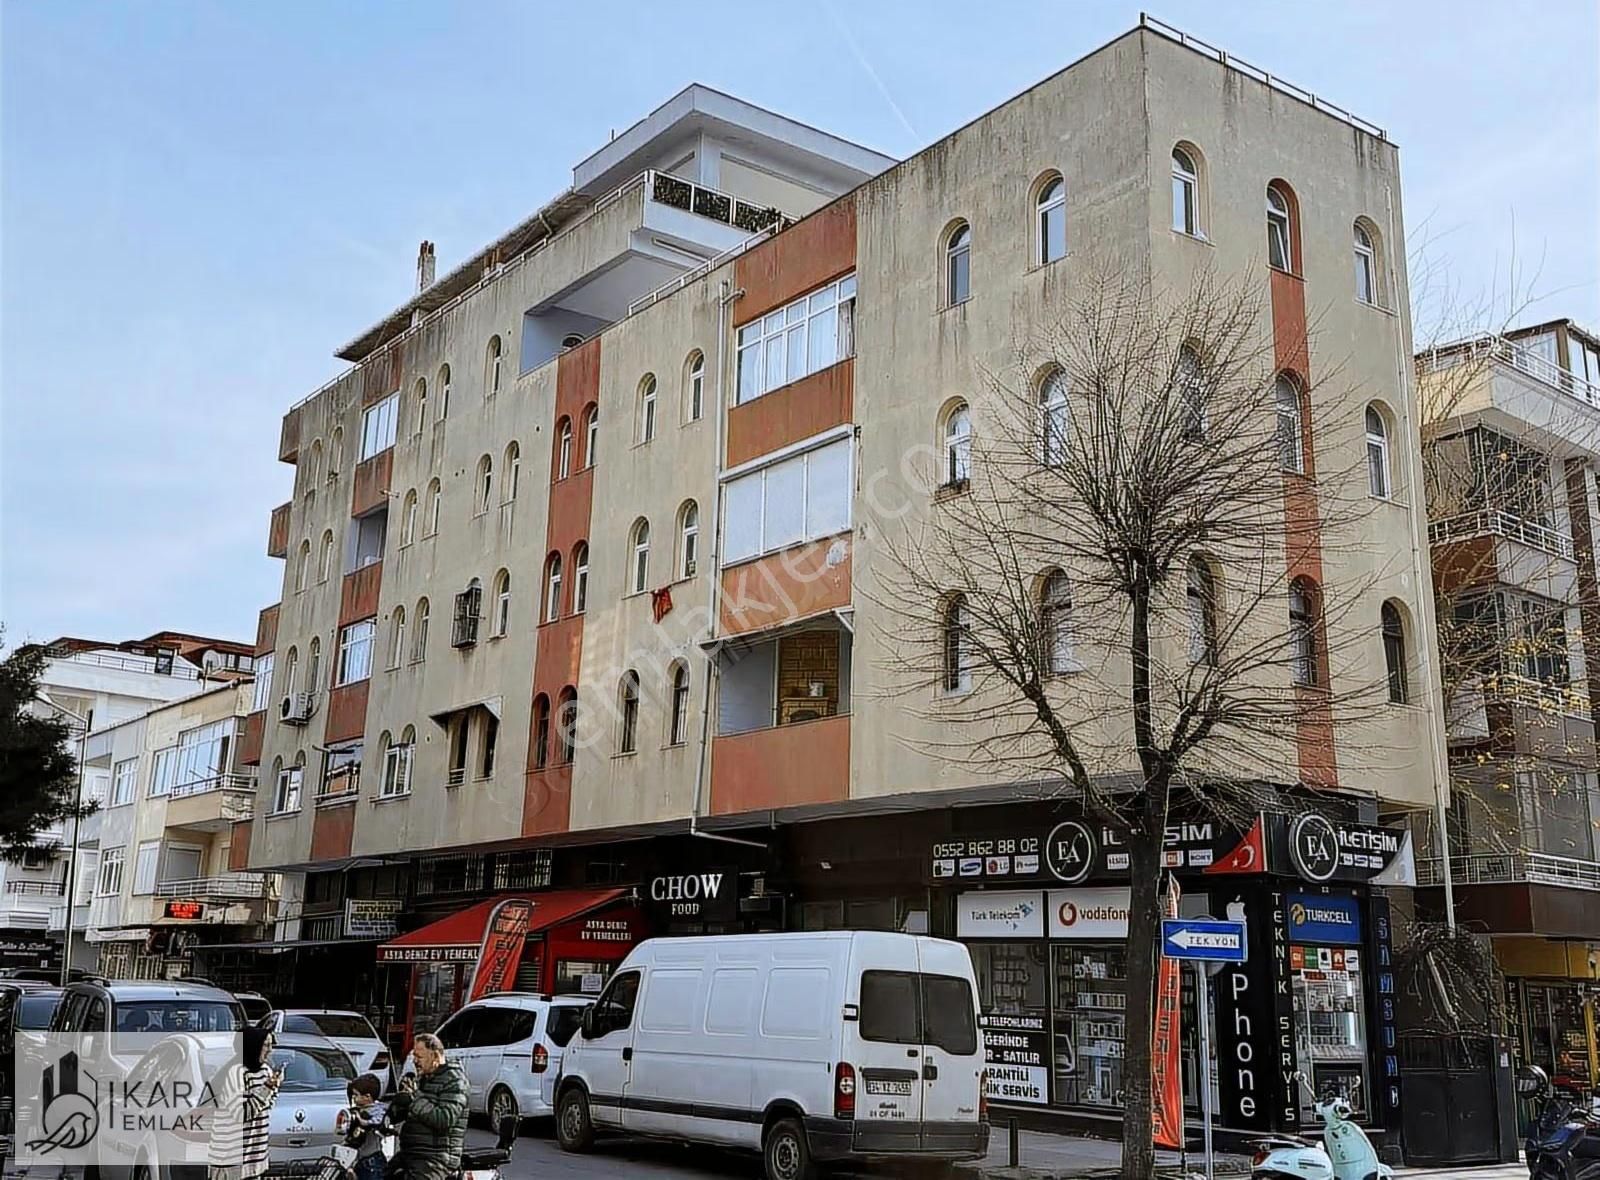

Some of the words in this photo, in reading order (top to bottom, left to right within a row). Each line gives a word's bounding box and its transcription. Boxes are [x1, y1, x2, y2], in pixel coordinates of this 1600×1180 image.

[1339, 826, 1398, 854] İLETİŞİM
[933, 843, 965, 858] 0552
[968, 840, 994, 856] 862
[998, 839, 1016, 854] 88
[1020, 838, 1039, 852] 02
[651, 873, 723, 900] CHOW
[671, 903, 699, 915] FOOD
[971, 911, 986, 921] Türk
[989, 910, 1021, 921] Telekom
[1306, 908, 1352, 924] TURKCELL
[581, 931, 591, 940] EV
[1189, 936, 1210, 945] TEK
[1214, 935, 1237, 946] YÖN
[431, 949, 442, 960] EV
[445, 948, 480, 960] YEMEKL
[985, 1032, 1029, 1048] ĞERİNDE
[1232, 962, 1256, 1118] Phone
[1003, 1050, 1040, 1065] SATILIR
[984, 1067, 1029, 1082] ARANTİLİ
[1279, 1016, 1295, 1121] SERVİS
[1002, 1083, 1040, 1098] SERVİS
